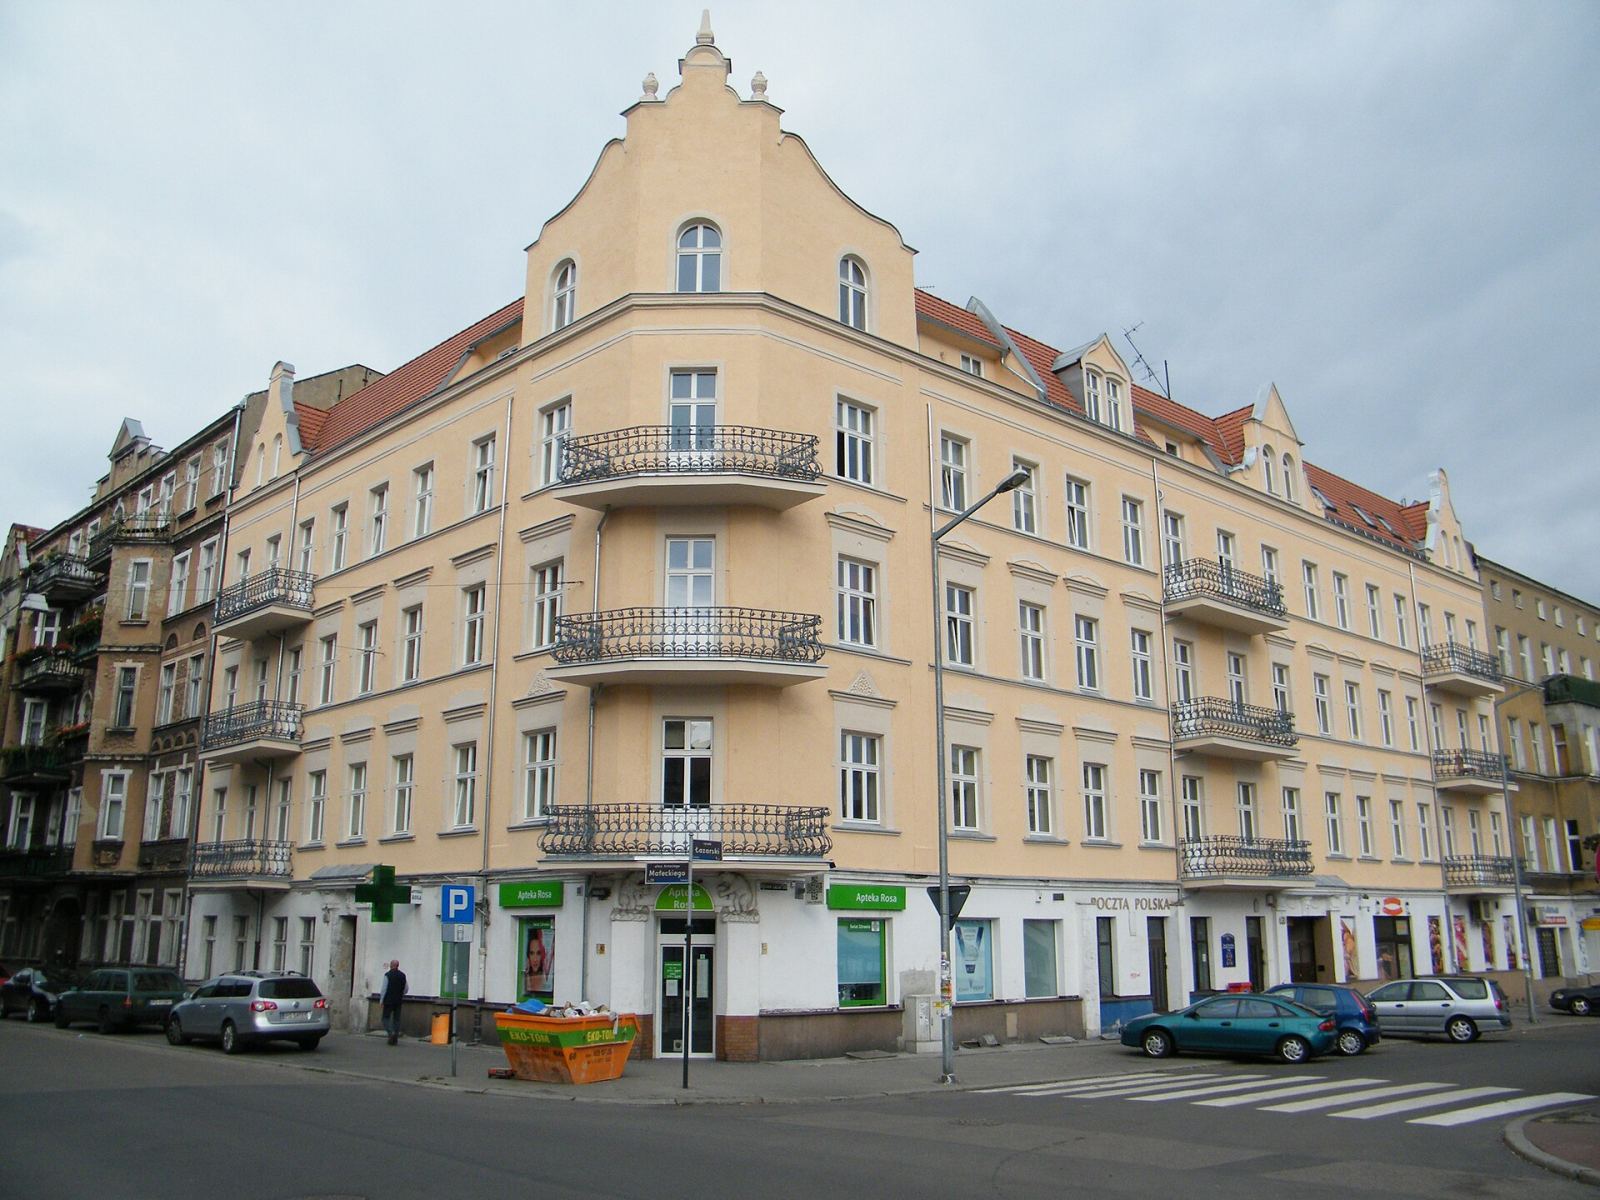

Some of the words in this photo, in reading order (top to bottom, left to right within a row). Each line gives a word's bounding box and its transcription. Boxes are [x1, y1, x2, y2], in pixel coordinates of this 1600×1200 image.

[517, 890, 537, 901] Apteka
[538, 889, 552, 899] Rosa
[856, 892, 879, 904] Apteka
[880, 893, 897, 903] Rosa
[449, 889, 468, 918] P
[1090, 897, 1129, 910] POCZTA
[1135, 898, 1170, 910] POLSKA
[509, 1030, 551, 1043] EKO-TOM
[587, 1030, 615, 1042] EKO-TOM
